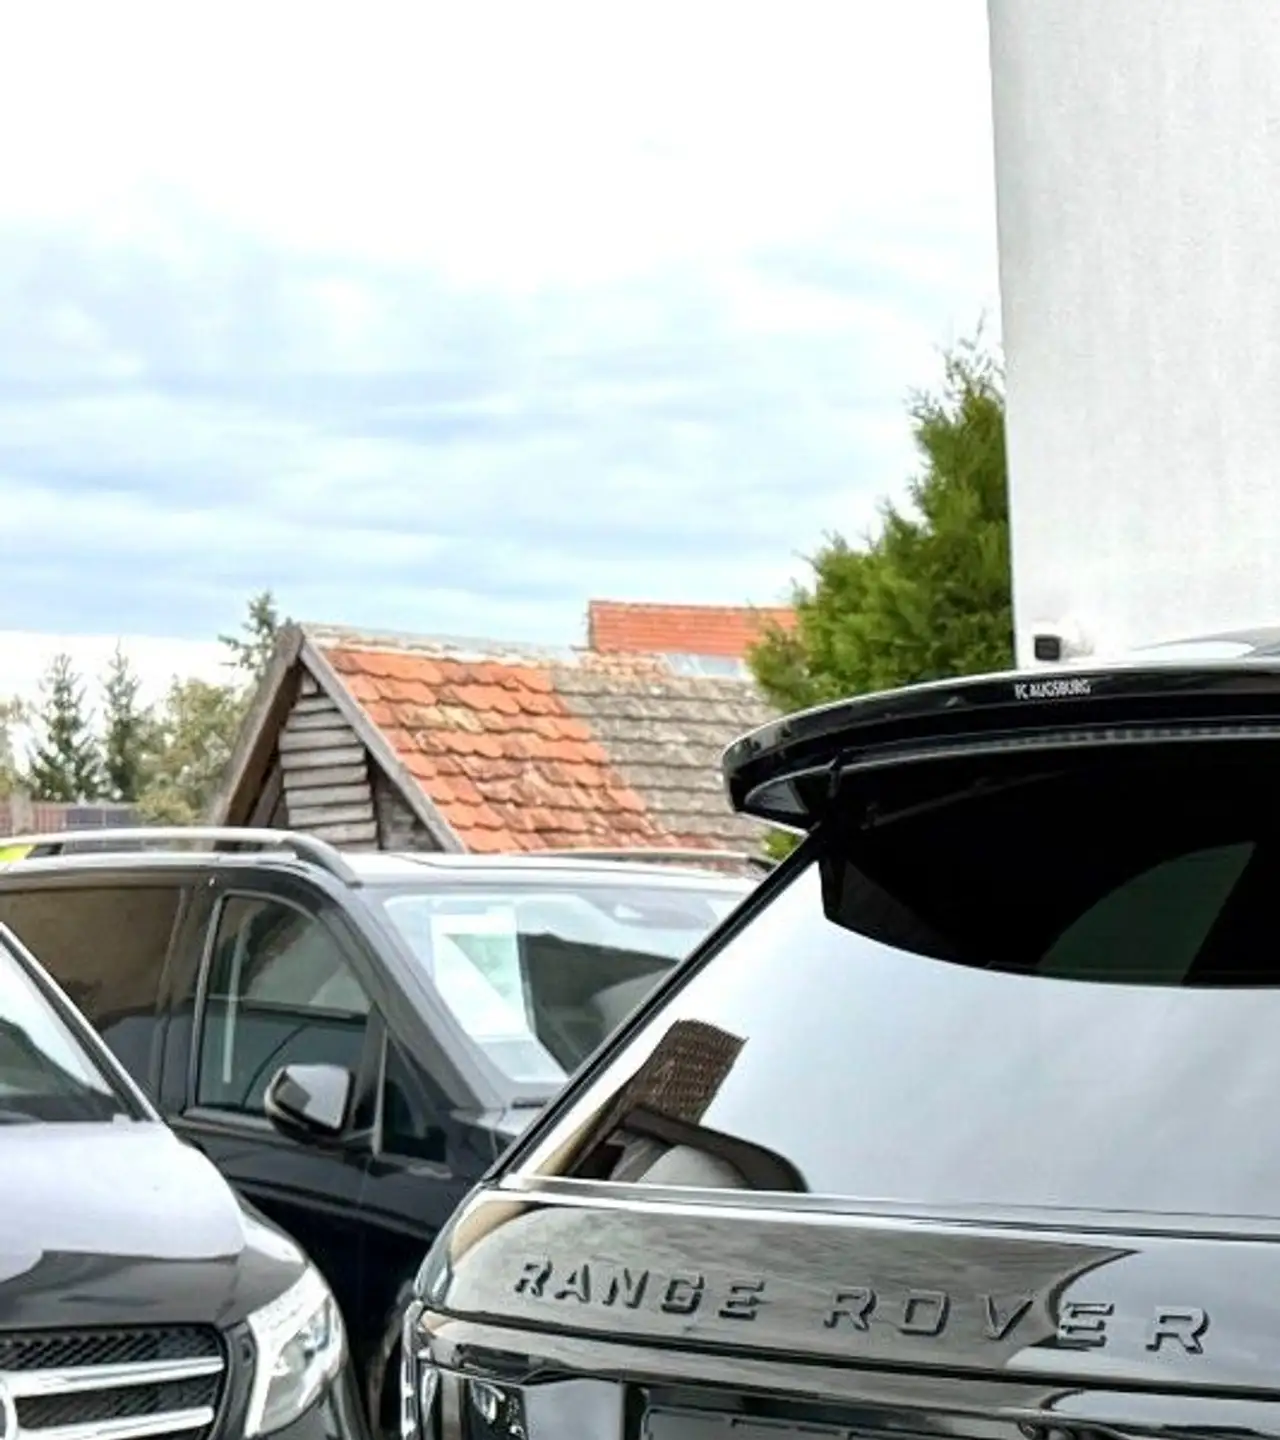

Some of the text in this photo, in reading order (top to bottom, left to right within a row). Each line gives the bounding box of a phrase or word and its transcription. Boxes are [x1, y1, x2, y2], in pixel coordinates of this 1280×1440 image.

[1029, 679, 1092, 699] AUGSBURG
[514, 1260, 1211, 1355] RANGE ROVER
